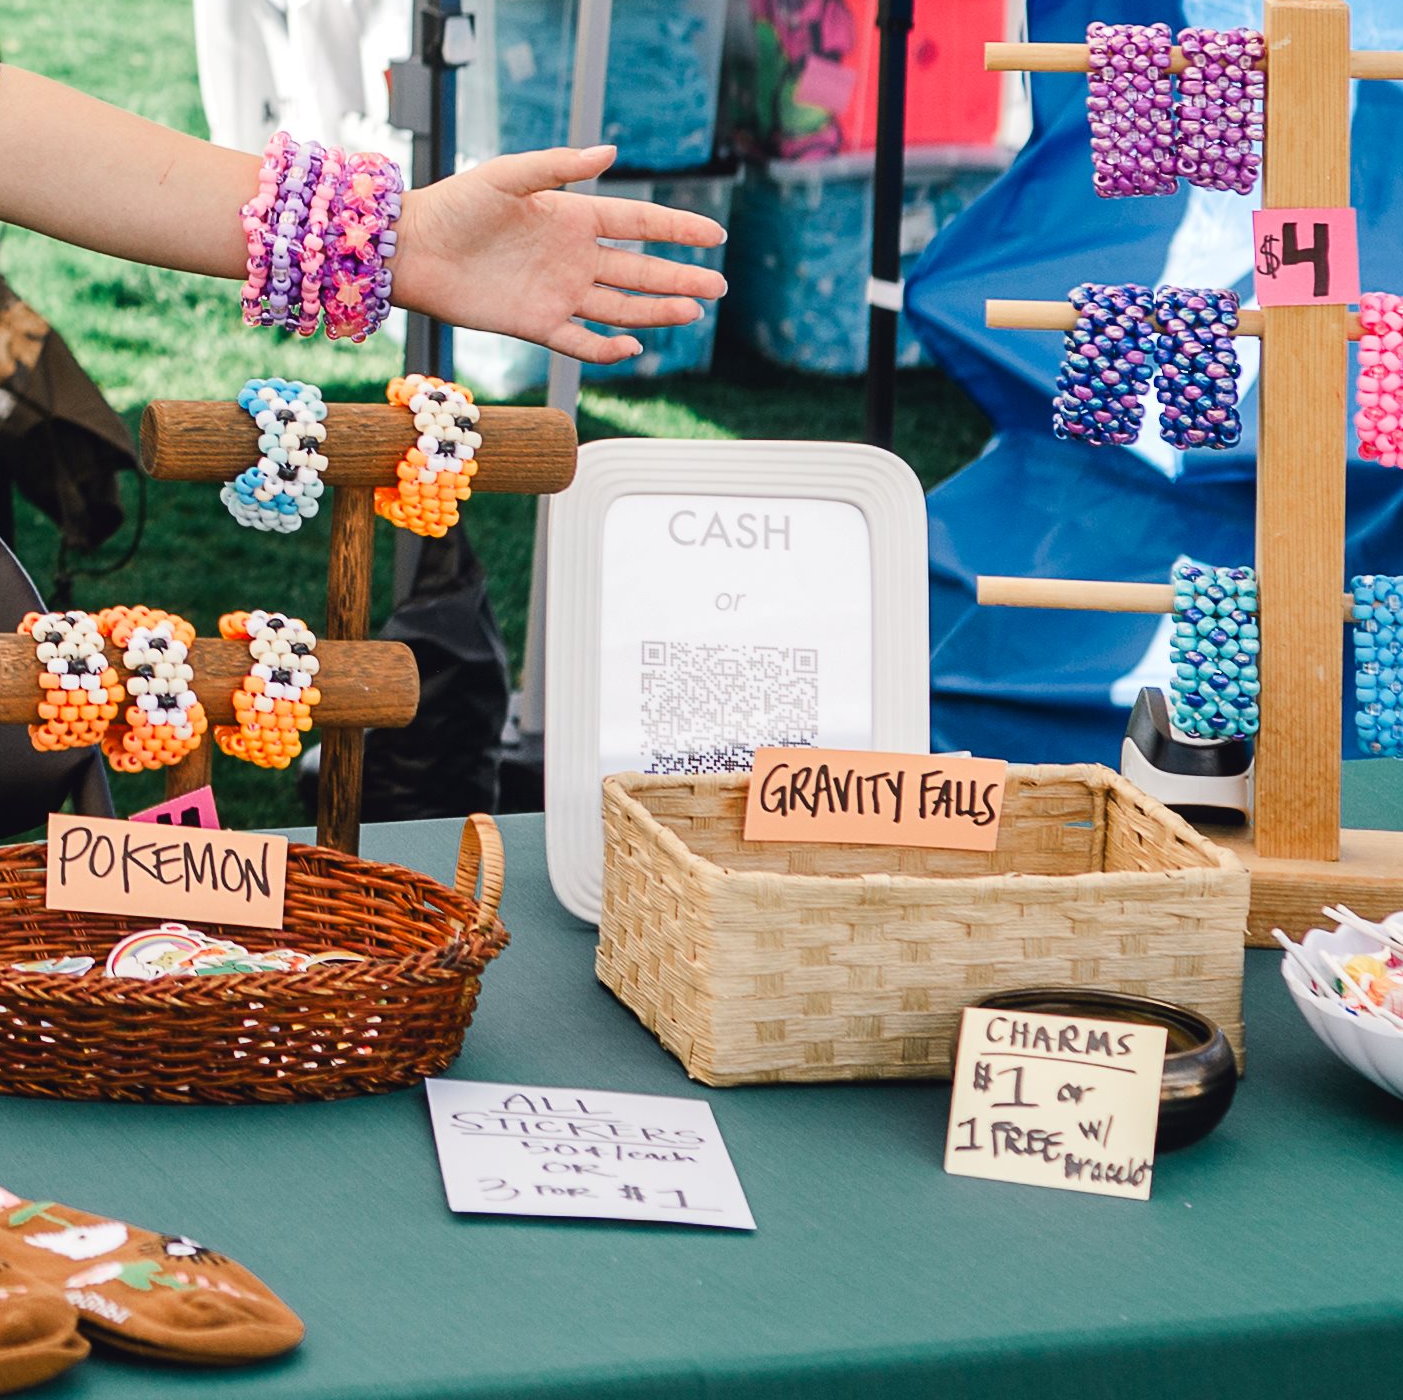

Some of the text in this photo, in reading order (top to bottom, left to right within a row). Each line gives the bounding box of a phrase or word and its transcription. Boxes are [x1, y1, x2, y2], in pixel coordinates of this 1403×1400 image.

[1256, 222, 1330, 297] $4
[668, 509, 791, 551] CASH
[714, 592, 747, 612] or
[760, 763, 999, 827] GRAVITY FALLS
[59, 826, 270, 902] POKEMON
[986, 1016, 1135, 1057] CHARMS
[502, 1093, 613, 1114] ALL
[973, 1060, 1097, 1108] $1 or
[451, 1111, 706, 1146] STICKERS
[954, 1117, 984, 1151] 1
[990, 1121, 1065, 1162] FREE
[478, 1177, 520, 1202] 3
[541, 1161, 618, 1178] OR
